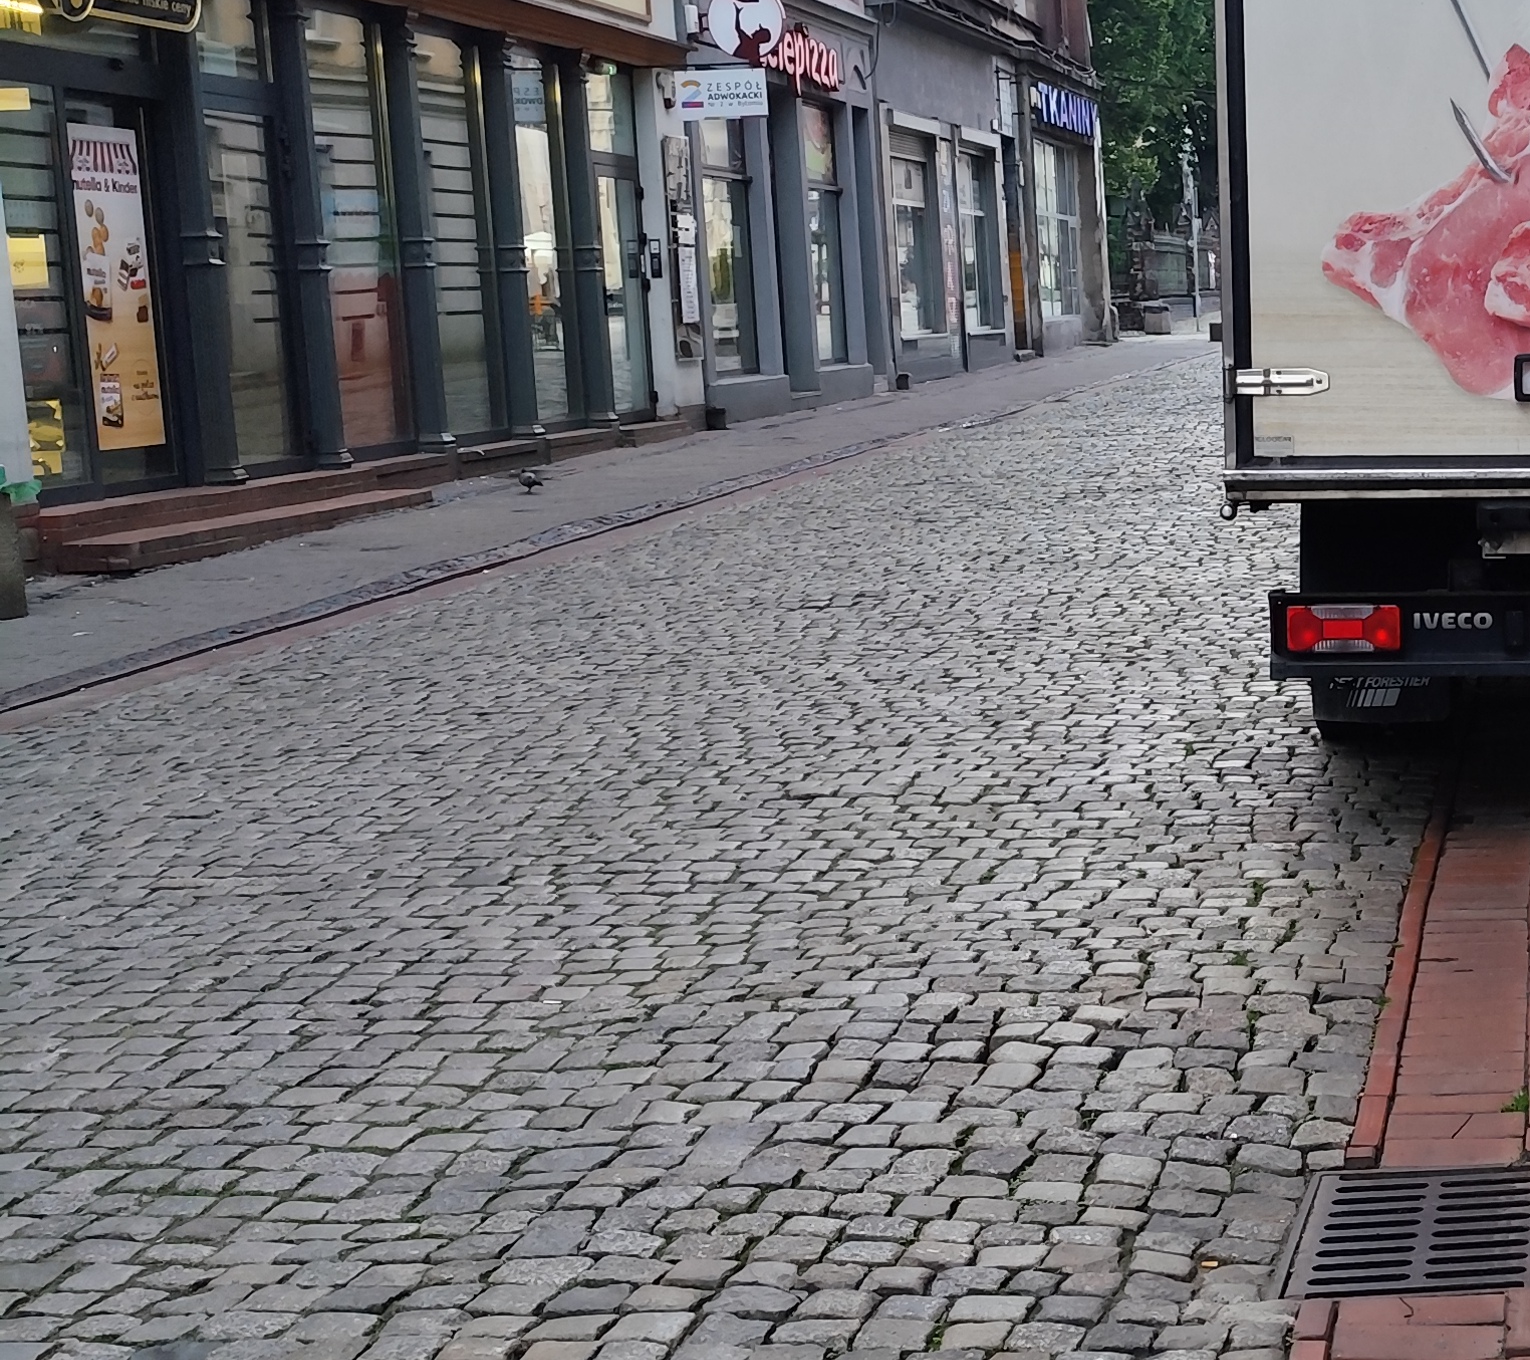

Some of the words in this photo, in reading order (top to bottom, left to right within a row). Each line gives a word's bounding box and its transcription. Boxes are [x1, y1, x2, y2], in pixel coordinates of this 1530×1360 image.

[171, 0, 192, 18] ceny
[706, 80, 762, 92] ZESPÓŁ
[707, 91, 763, 101] ADWOKACKI
[1037, 81, 1098, 138] TKANINY
[104, 177, 110, 193] &
[1412, 612, 1493, 630] IVECO
